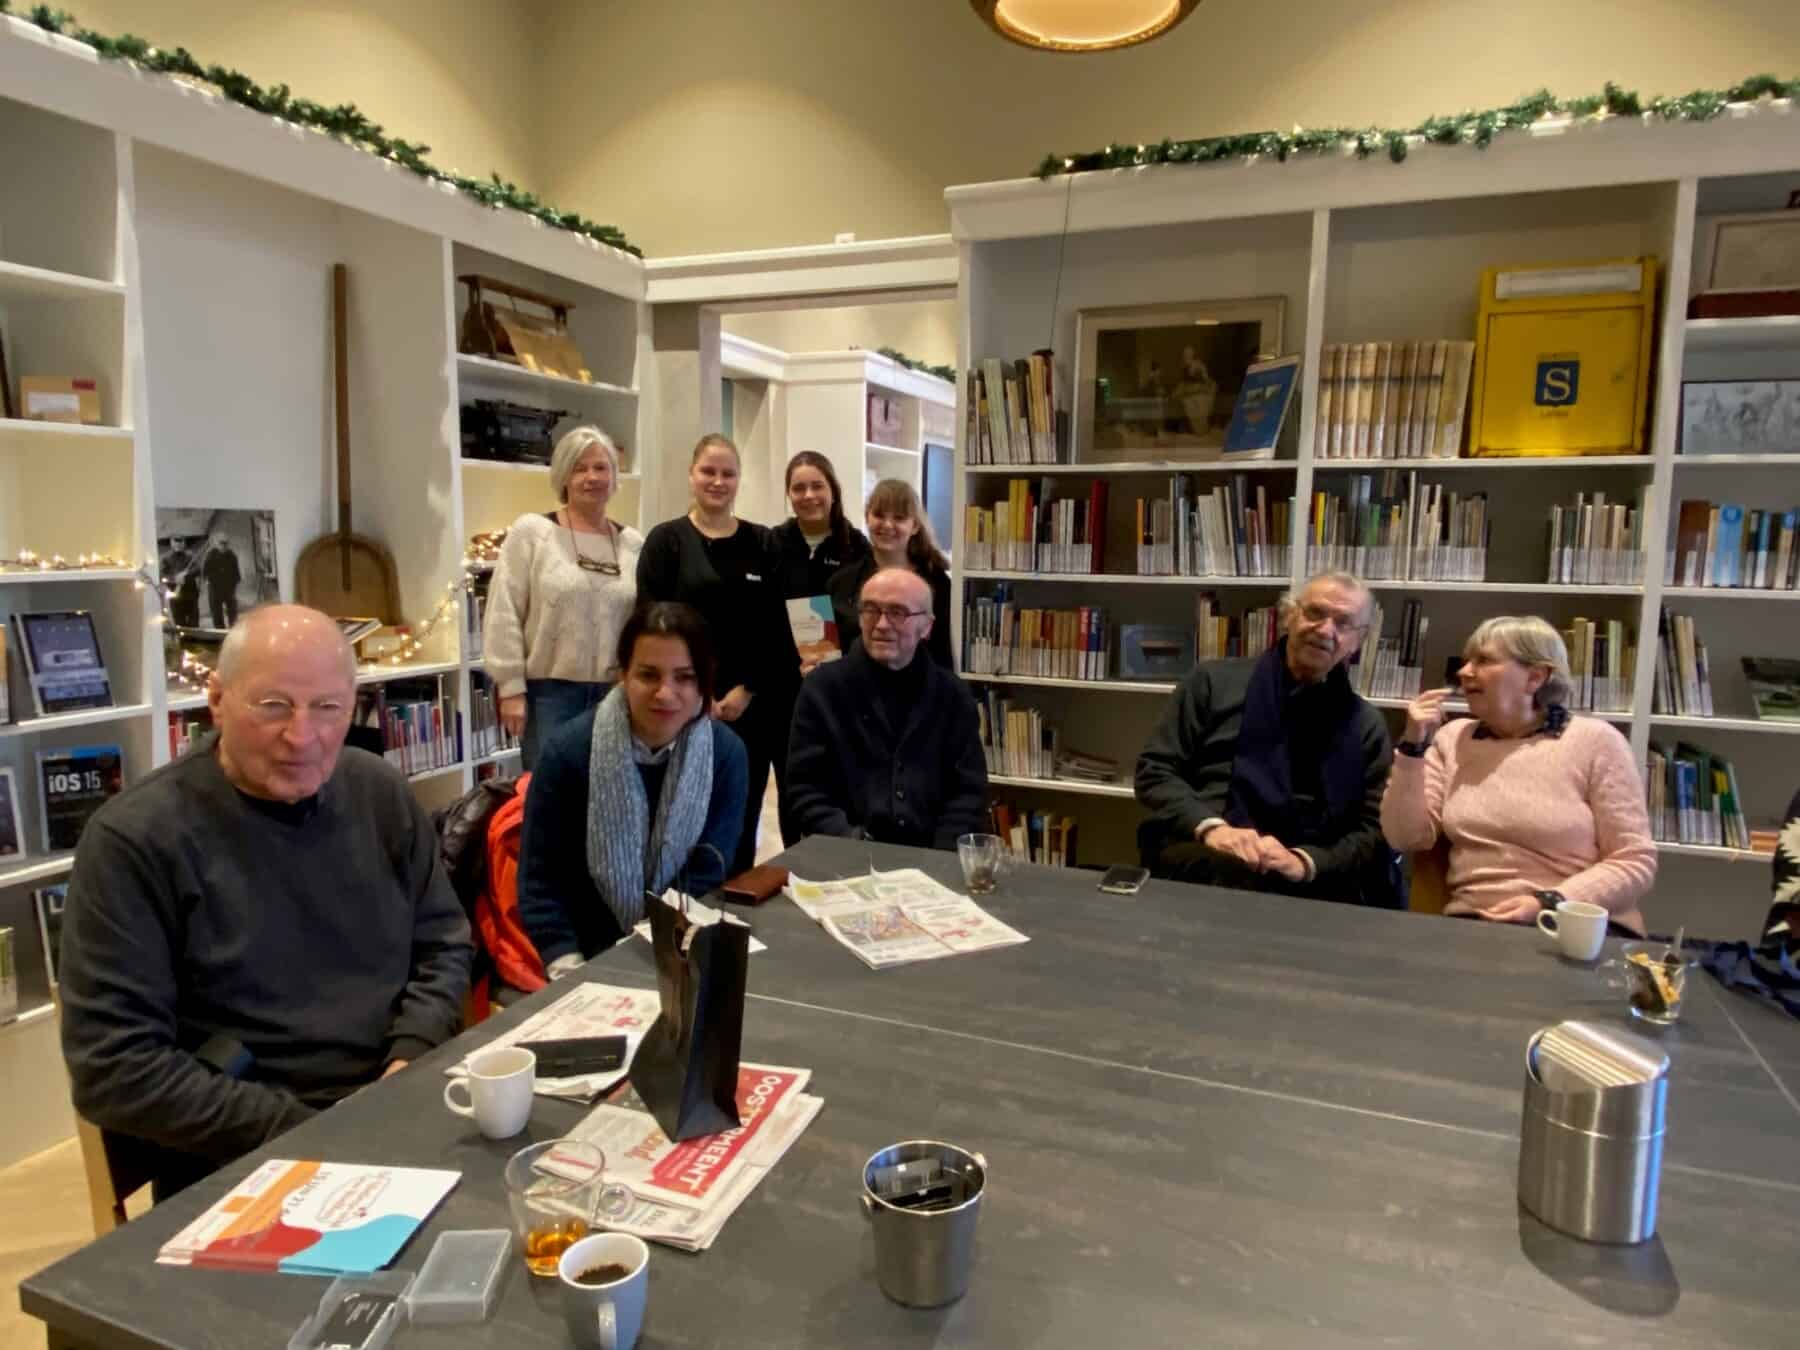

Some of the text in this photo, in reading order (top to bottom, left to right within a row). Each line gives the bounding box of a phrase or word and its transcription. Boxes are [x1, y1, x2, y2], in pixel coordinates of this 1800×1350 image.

[1543, 367, 1571, 401] S
[48, 769, 101, 793] iOS 15
